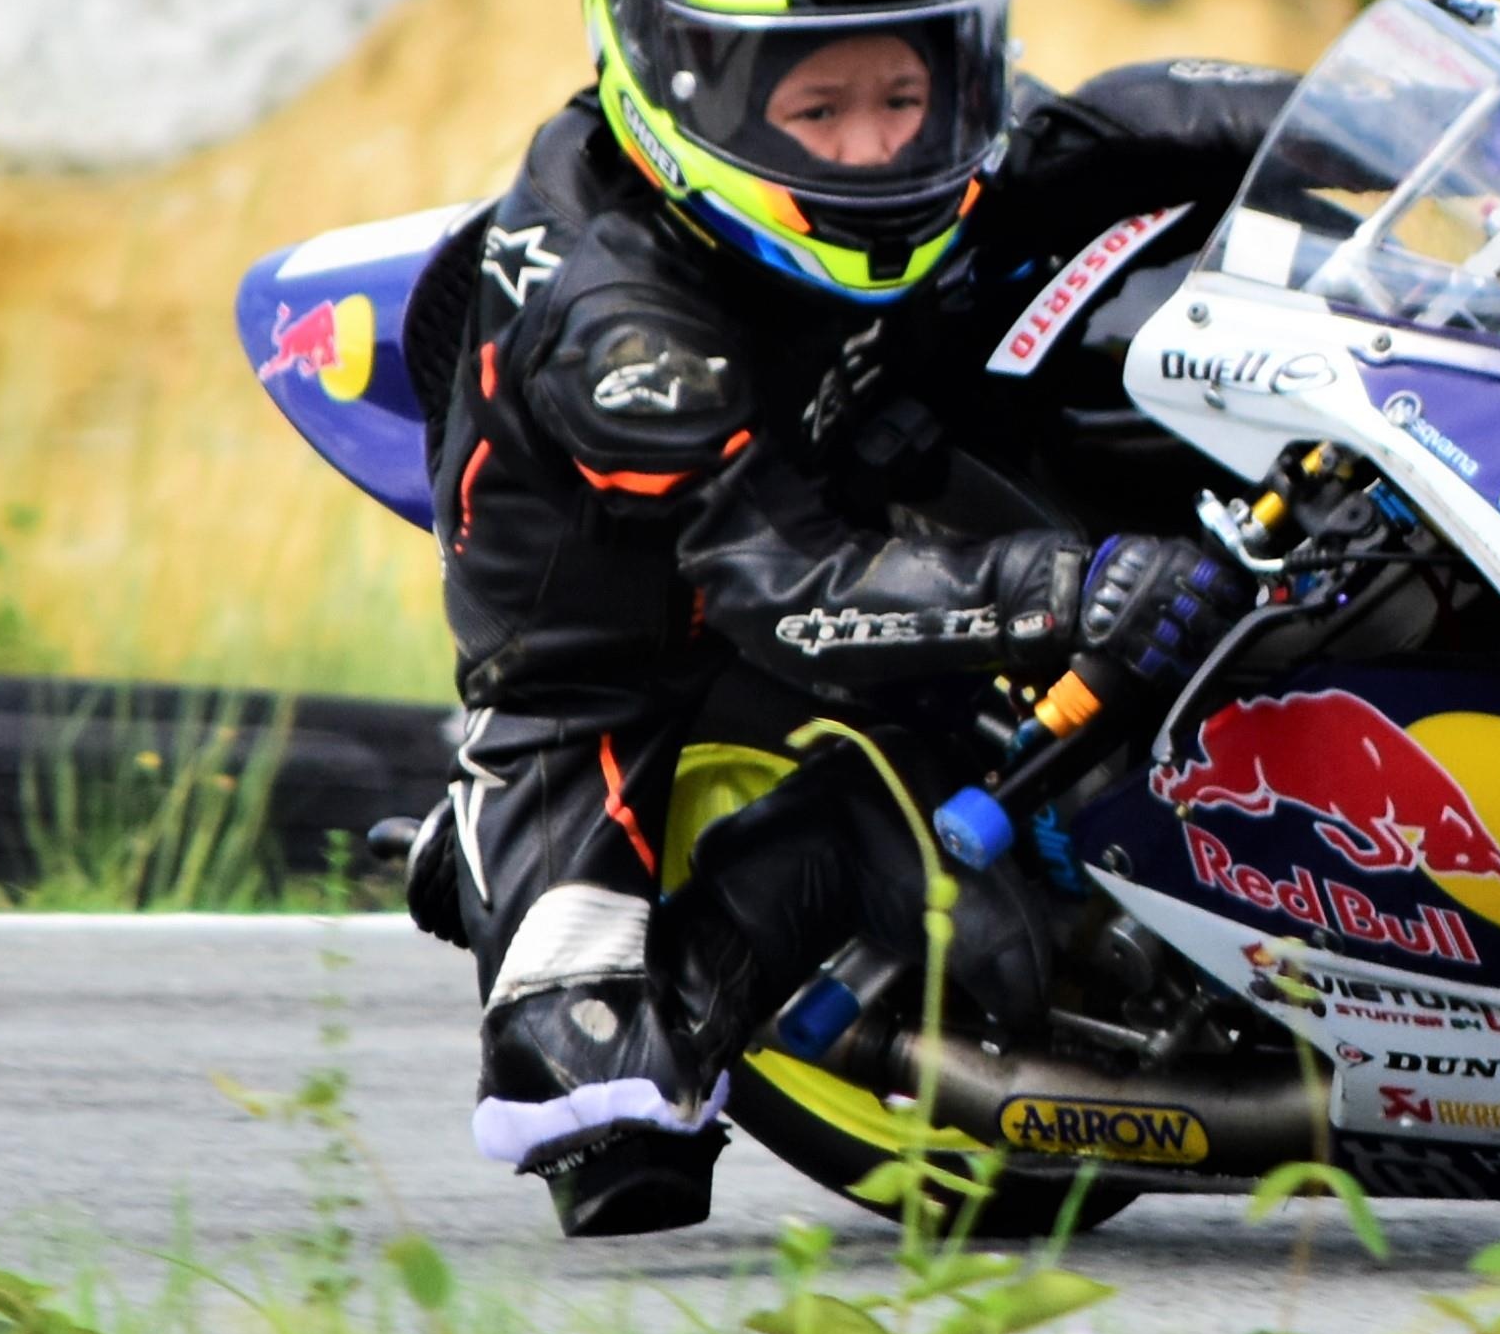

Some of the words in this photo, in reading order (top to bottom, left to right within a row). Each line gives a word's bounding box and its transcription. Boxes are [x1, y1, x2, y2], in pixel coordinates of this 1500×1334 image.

[622, 95, 679, 185] SHOEI
[1183, 821, 1328, 929] Red
[1322, 878, 1481, 965] Bull
[1012, 1104, 1191, 1151] ARROW
